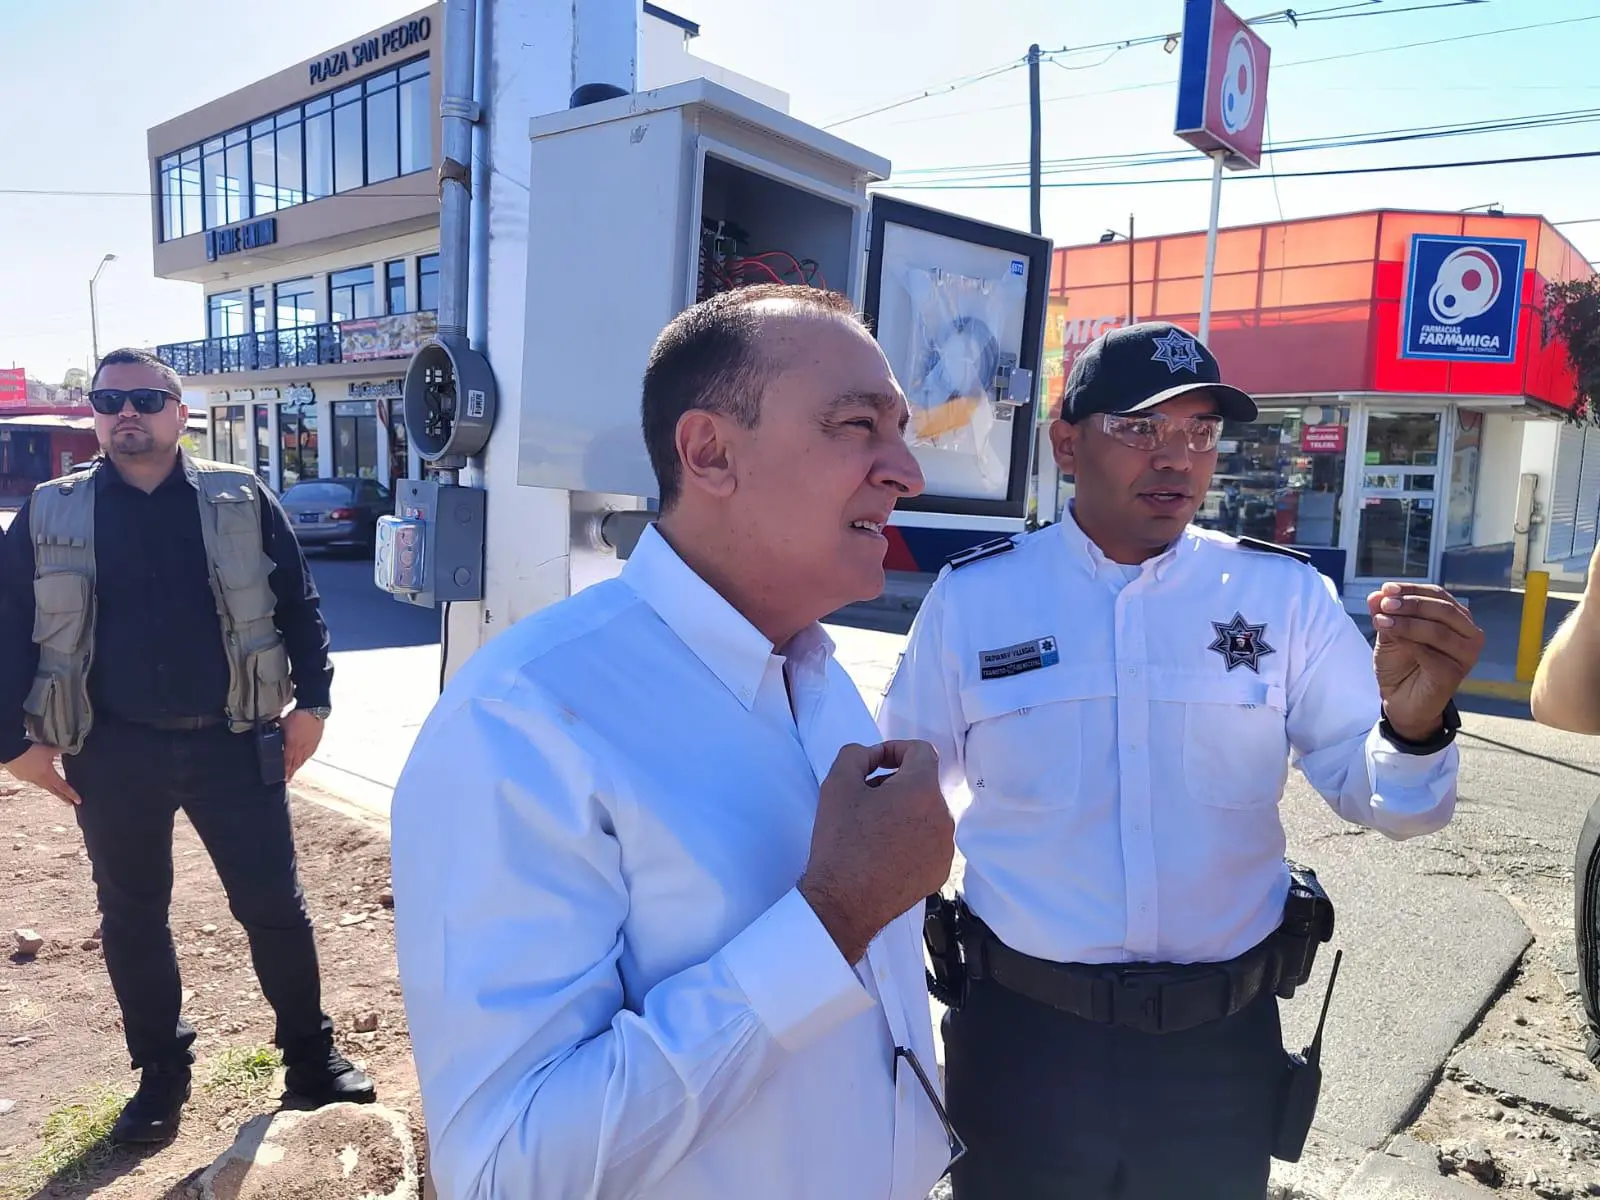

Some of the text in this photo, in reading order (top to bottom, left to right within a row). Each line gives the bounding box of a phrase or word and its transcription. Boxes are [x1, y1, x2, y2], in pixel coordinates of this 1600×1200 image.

[310, 16, 431, 85] PLAZA SAN PEDRO
[1421, 324, 1461, 334] FARMACIAS
[1419, 332, 1500, 348] FARMAMIGA
